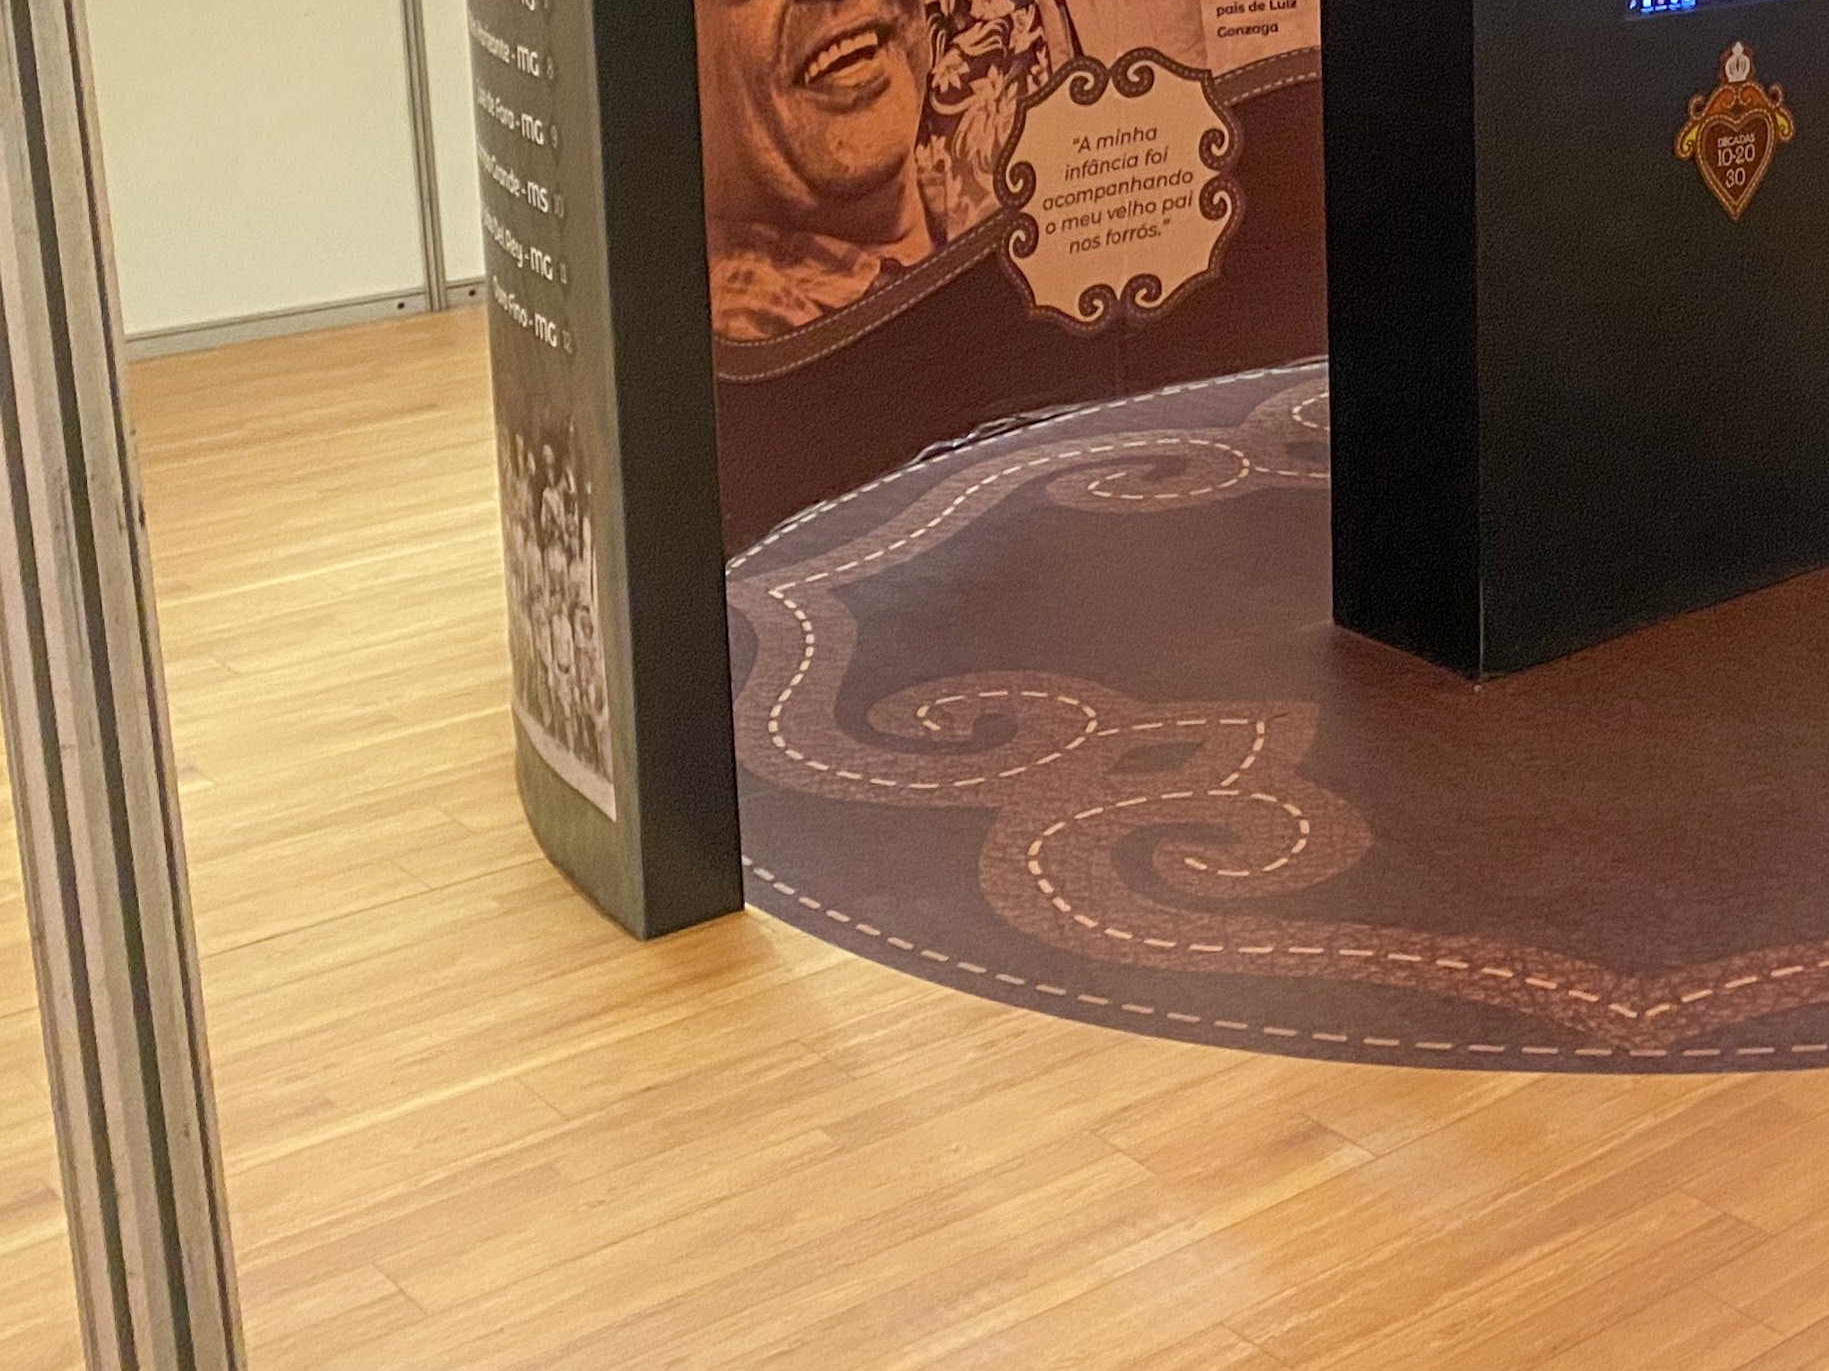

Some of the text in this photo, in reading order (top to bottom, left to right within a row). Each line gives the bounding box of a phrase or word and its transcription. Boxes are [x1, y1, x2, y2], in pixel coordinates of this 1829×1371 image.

[1216, 1, 1245, 18] pais
[1249, 1, 1266, 12] de
[1217, 22, 1279, 38] Gonzaga
[1096, 127, 1157, 150] minha
[1065, 145, 1169, 181] infância foi
[1725, 167, 1746, 188] 30
[1042, 169, 1194, 211] acompanhando
[1045, 190, 1194, 235] o meu velho pai
[1069, 235, 1101, 255] nos
